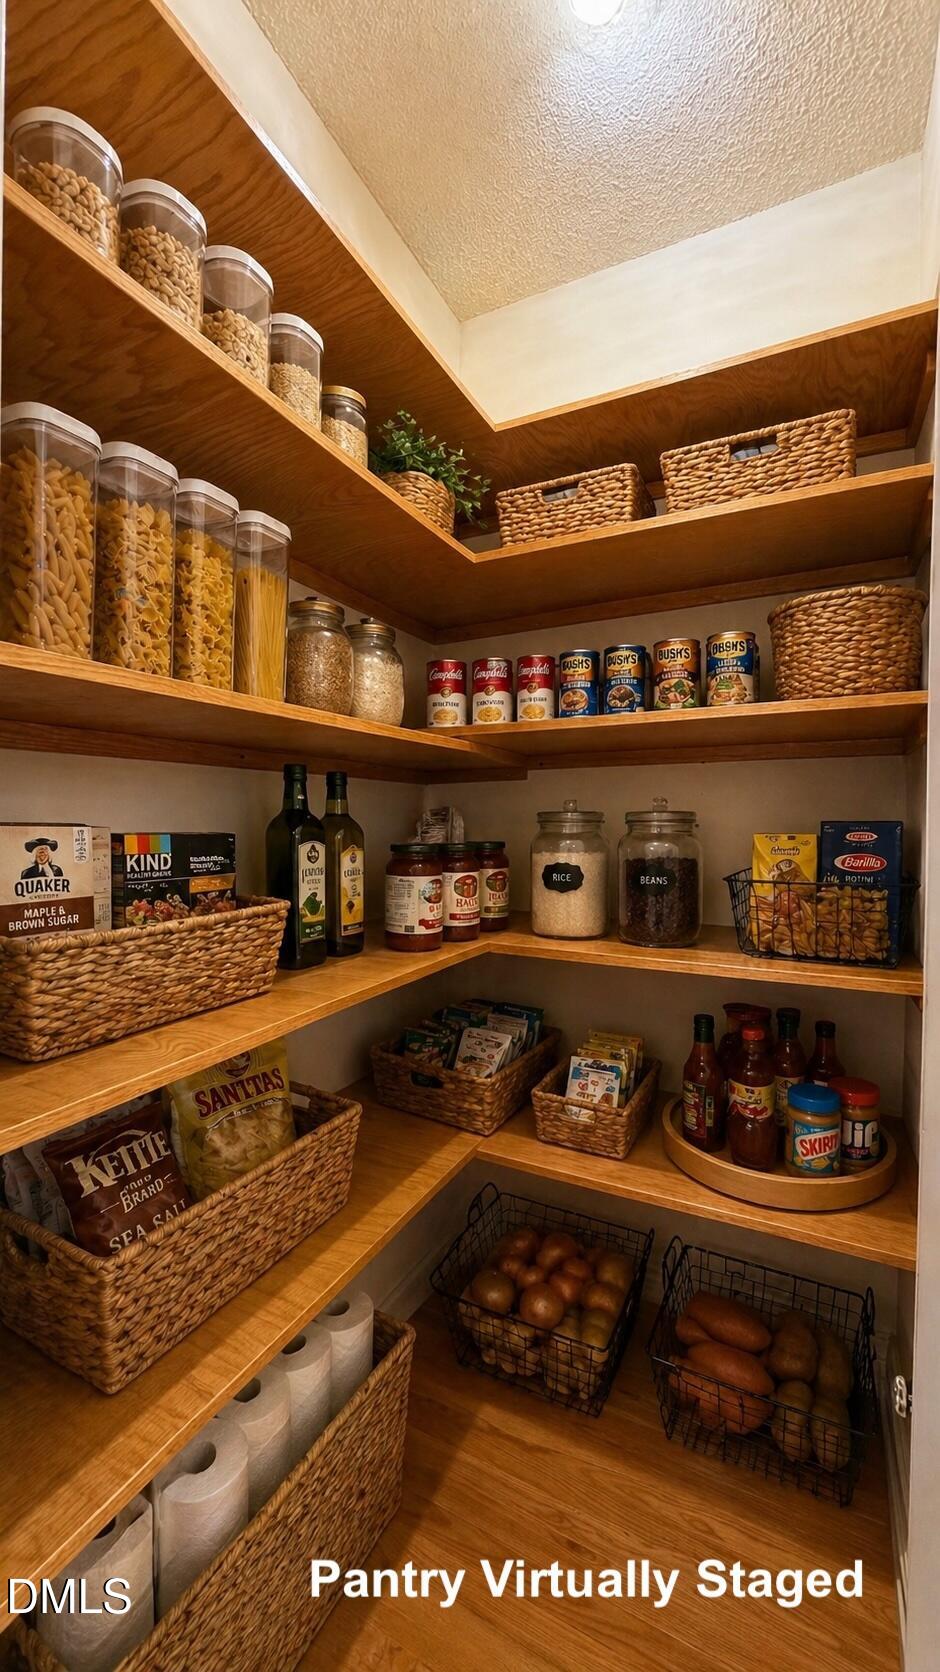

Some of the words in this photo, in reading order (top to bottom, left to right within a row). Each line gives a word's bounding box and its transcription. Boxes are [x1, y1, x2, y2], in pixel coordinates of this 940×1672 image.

[126, 853, 172, 872] KIND
[552, 873, 572, 882] RICE
[639, 875, 668, 885] BEANS
[14, 878, 70, 897] QUAKER
[24, 906, 57, 919] MAPLE
[8, 918, 45, 931] BROWN
[47, 914, 80, 927] SUGAR
